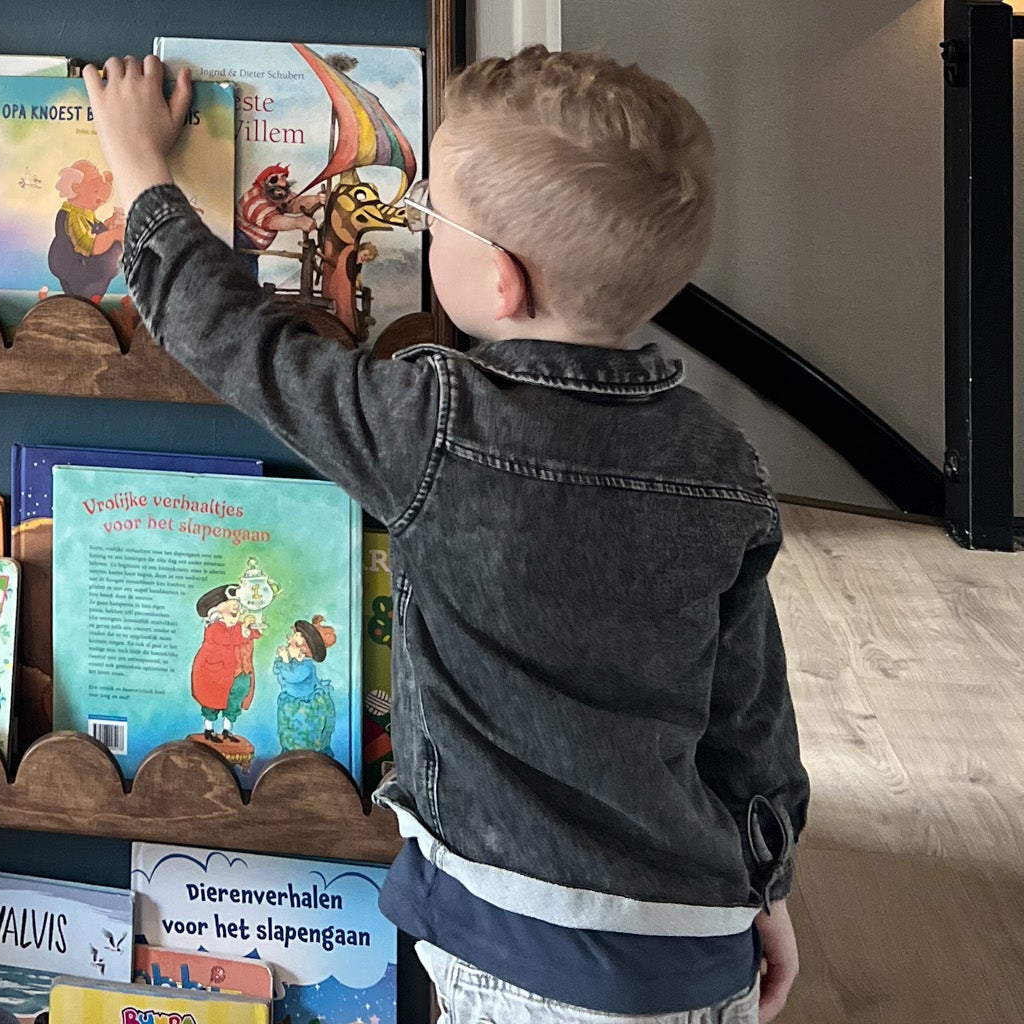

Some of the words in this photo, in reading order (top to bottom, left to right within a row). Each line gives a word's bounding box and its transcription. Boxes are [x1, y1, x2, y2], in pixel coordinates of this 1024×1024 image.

[200, 67, 226, 78] Ingrid
[228, 69, 237, 77] &
[239, 68, 266, 78] Dieter
[267, 70, 305, 80] Schubert
[2, 104, 26, 120] OPA
[31, 105, 83, 121] KNOEST
[82, 491, 148, 516] Vrolijke
[152, 494, 244, 519] verhaaltjes
[103, 517, 142, 534] voor
[147, 513, 174, 532] het
[178, 517, 271, 547] slapengaan
[186, 882, 343, 910] Dierenverhalen
[162, 918, 209, 936] voor
[214, 913, 250, 940] het
[257, 917, 371, 952] slapengaan
